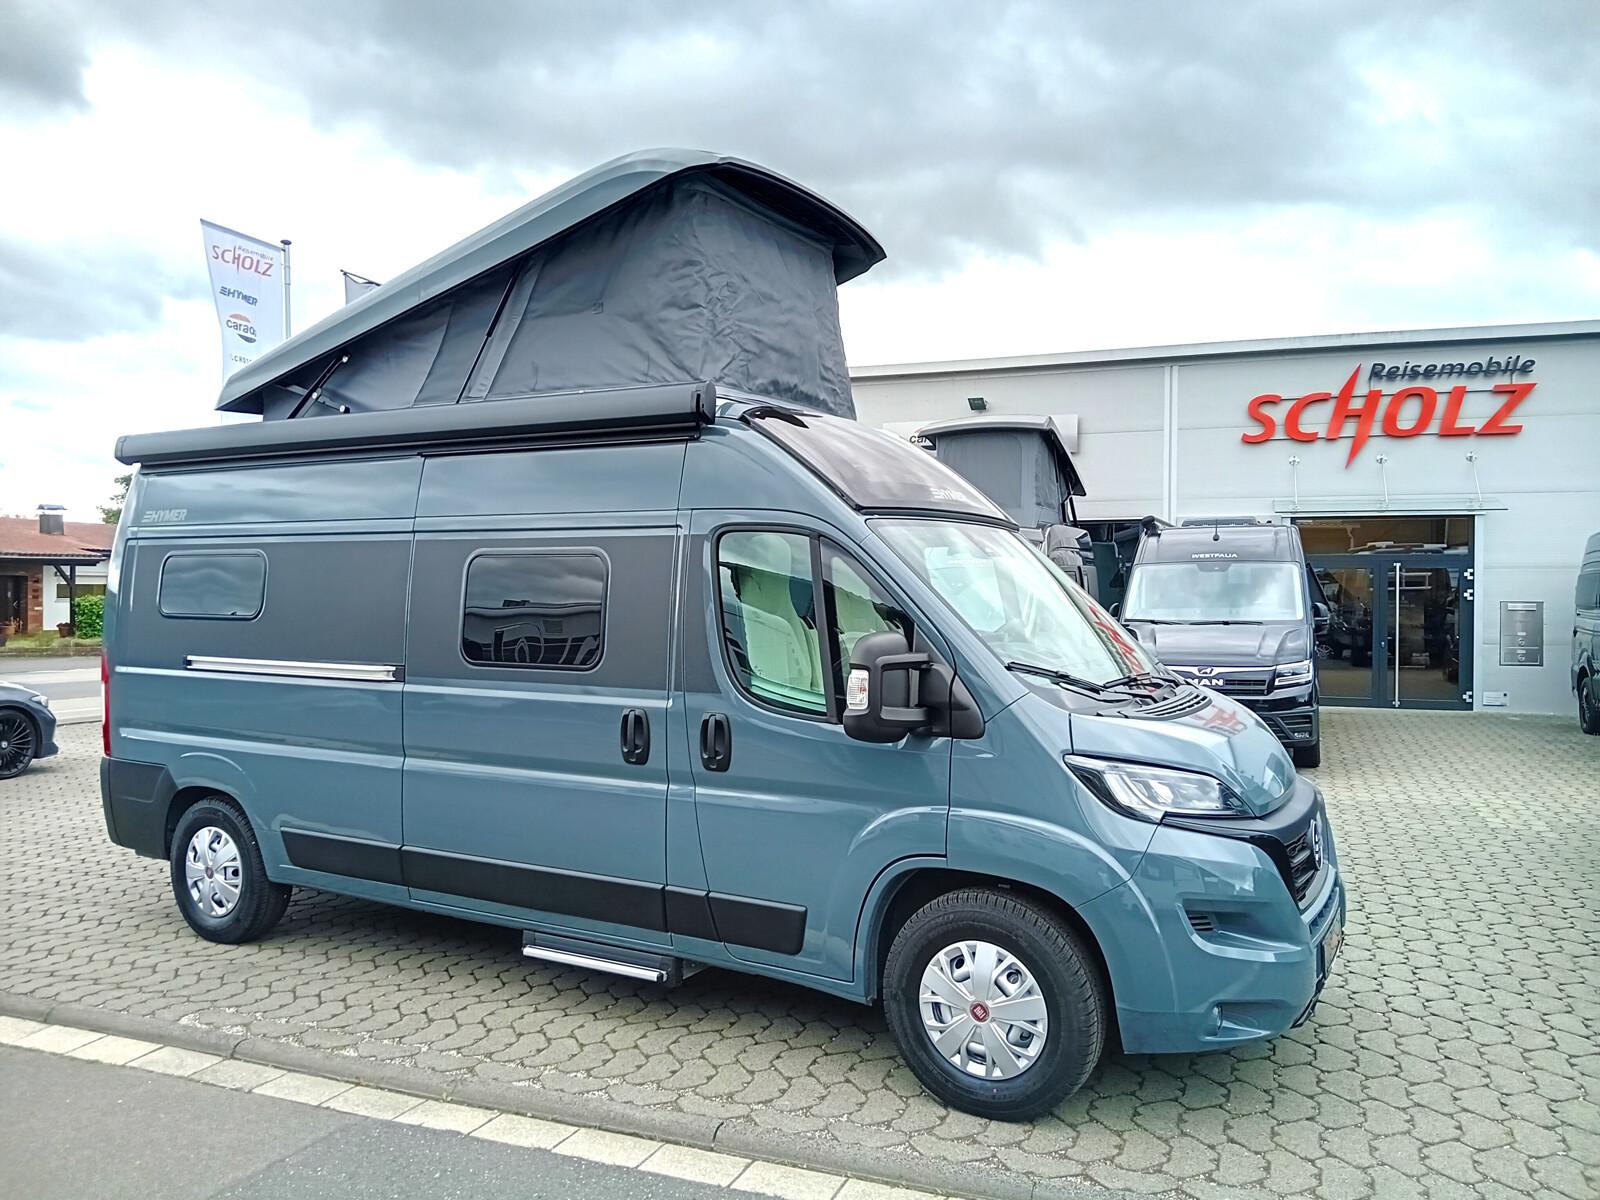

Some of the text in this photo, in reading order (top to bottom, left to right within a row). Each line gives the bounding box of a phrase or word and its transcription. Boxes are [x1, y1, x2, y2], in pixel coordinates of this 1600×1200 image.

[212, 245, 274, 277] SCHOLZ
[1370, 355, 1536, 381] Reisemobile
[1241, 363, 1537, 469] SCHOLZ
[143, 509, 188, 522] HYMER
